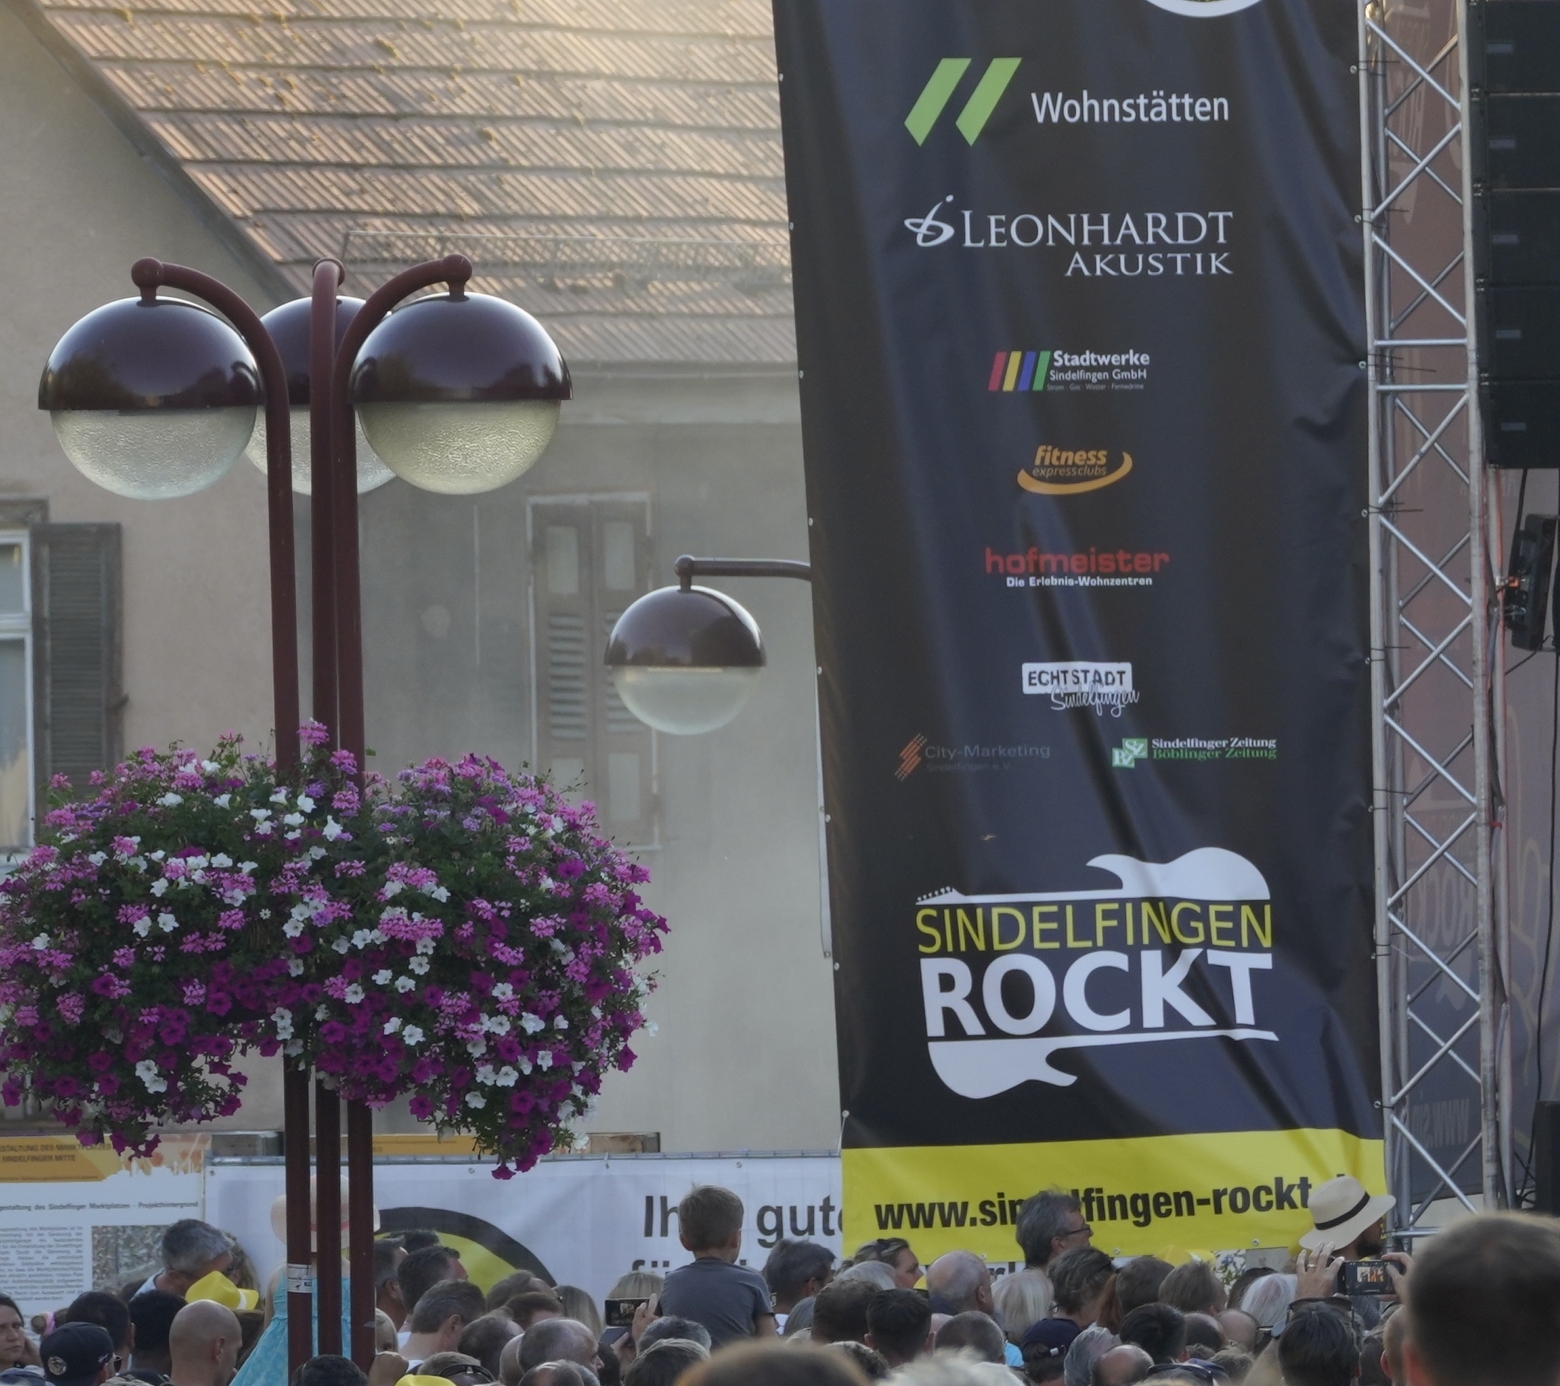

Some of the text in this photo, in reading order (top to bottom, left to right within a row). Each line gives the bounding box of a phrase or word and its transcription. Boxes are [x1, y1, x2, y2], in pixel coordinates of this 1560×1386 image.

[1031, 90, 1229, 124] Wohnstätten
[960, 211, 1234, 248] LEONHARDT
[1064, 251, 1234, 277] AKUSTIK
[1053, 349, 1150, 367] Stadtwerke
[1050, 368, 1147, 383] Sindelfingen GmbH
[1034, 445, 1107, 466] fitness
[1032, 465, 1107, 479] expressclubs
[985, 546, 1170, 574] hofmeister
[1006, 576, 1152, 587] Die Erlebnis-Wohnzentren
[1028, 668, 1126, 686] ECHT STADT
[1051, 680, 1140, 718] Sindelfingen
[925, 744, 1051, 760] City-Marketing
[1152, 737, 1277, 750] Sindelfinger Zeitung
[1153, 748, 1277, 761] Böblinger Zeitung
[915, 901, 1273, 953] SINDELFINGEN
[919, 948, 1273, 1037] ROCKT
[756, 1195, 843, 1248] gut
